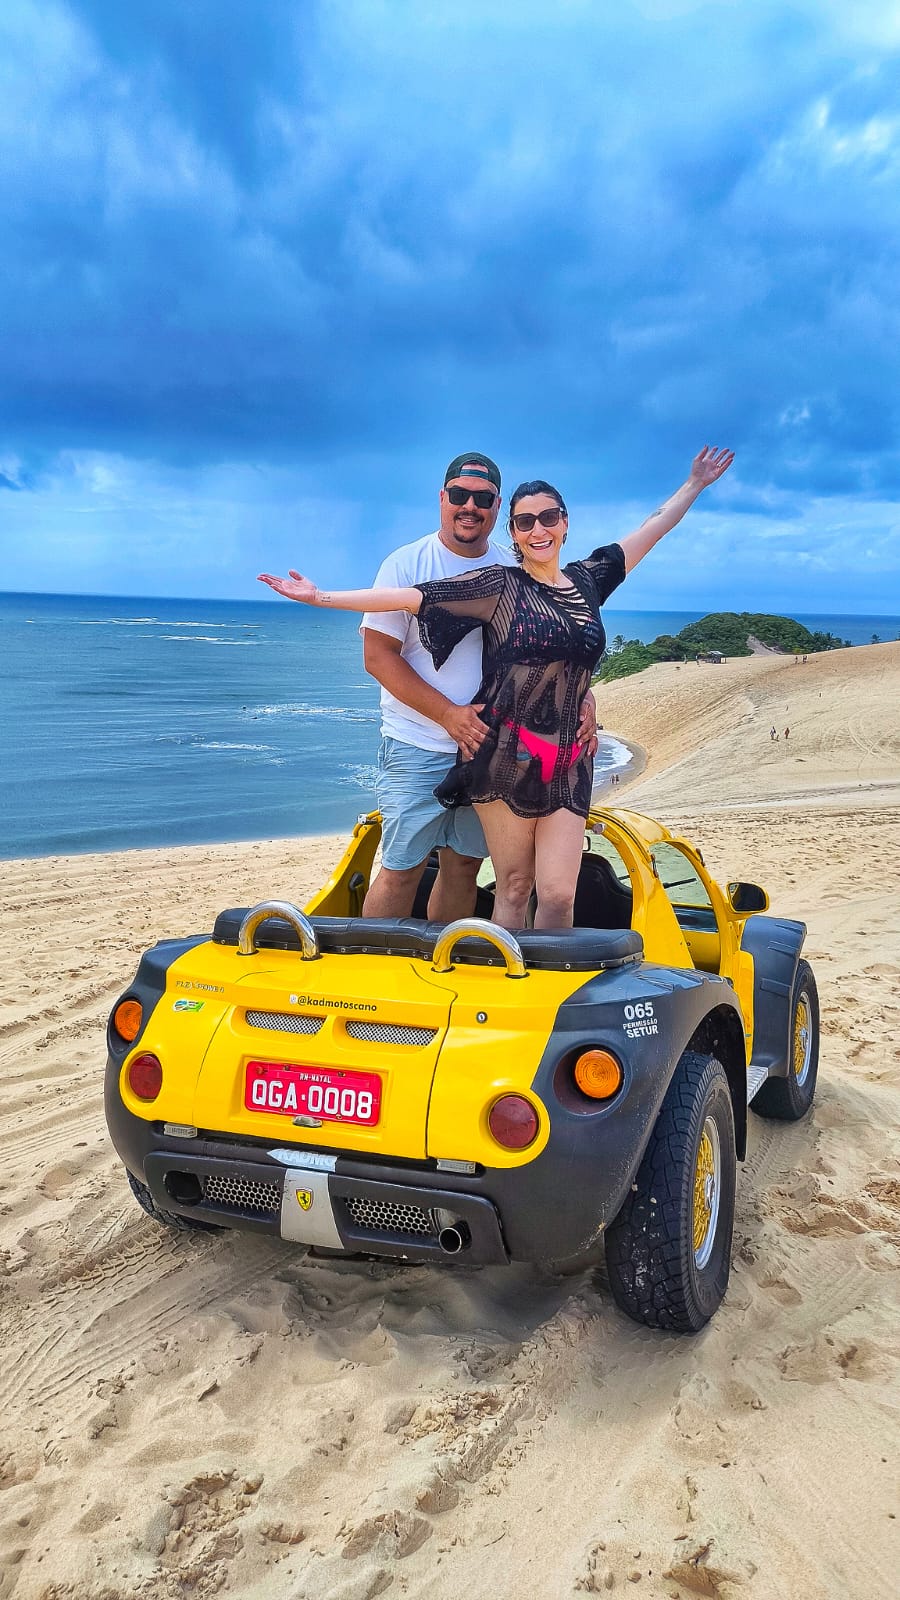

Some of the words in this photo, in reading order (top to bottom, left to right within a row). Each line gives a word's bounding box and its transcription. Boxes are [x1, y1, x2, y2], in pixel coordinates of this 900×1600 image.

[298, 995, 377, 1011] @kadmotoscano
[624, 1002, 653, 1020] 065
[626, 1025, 658, 1038] SETUR
